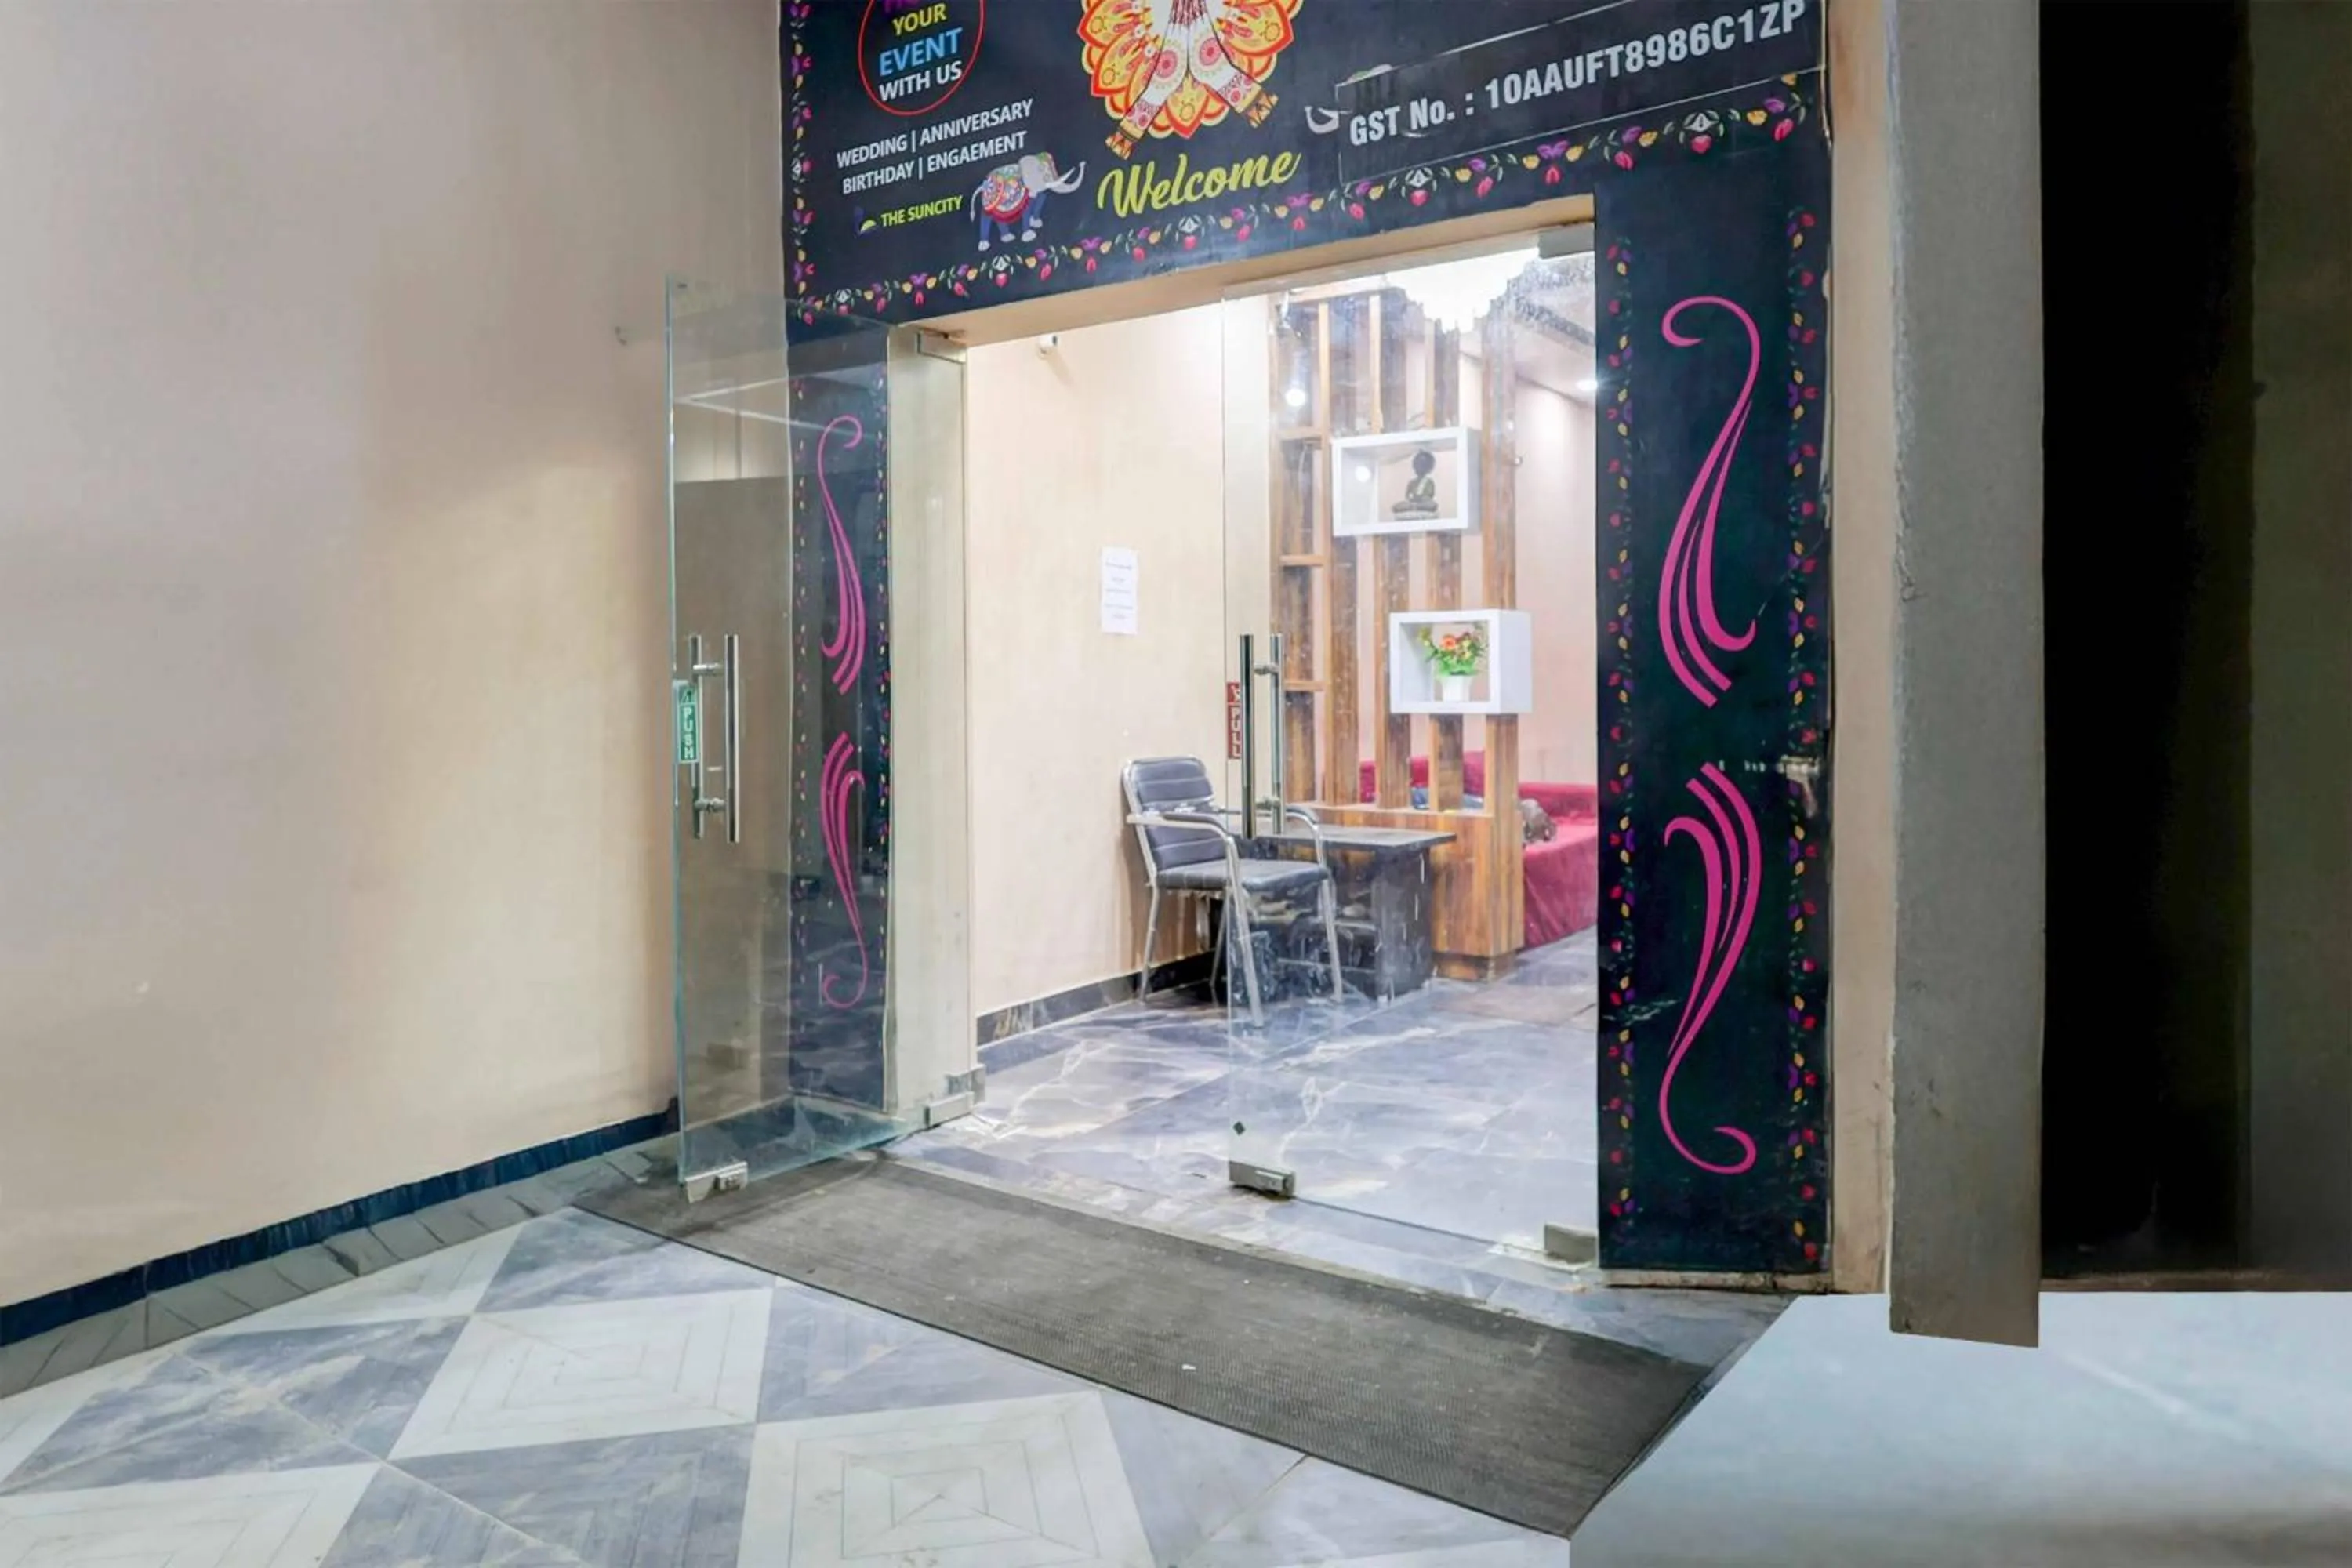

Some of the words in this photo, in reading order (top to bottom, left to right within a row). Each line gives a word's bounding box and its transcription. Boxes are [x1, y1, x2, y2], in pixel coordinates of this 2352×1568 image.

[892, 3, 947, 35] YOUR
[880, 27, 963, 76] EVENT
[1349, 105, 1401, 146] GST
[1409, 97, 1455, 130] No.
[1485, 0, 1805, 109] 10AAUFT8986C1ZP
[878, 70, 931, 102] WITH
[936, 60, 963, 85] US
[837, 134, 908, 169] WEDDING
[920, 98, 1033, 147] ANNIVERSARY
[843, 159, 915, 194] BIRTHDAY
[927, 130, 1028, 172] ENGAEMENT
[1098, 151, 1302, 219] Welcome
[880, 209, 905, 228] THE
[907, 195, 964, 222] SUNCITY
[683, 706, 695, 760] PUSH
[1231, 706, 1243, 757] PULL
